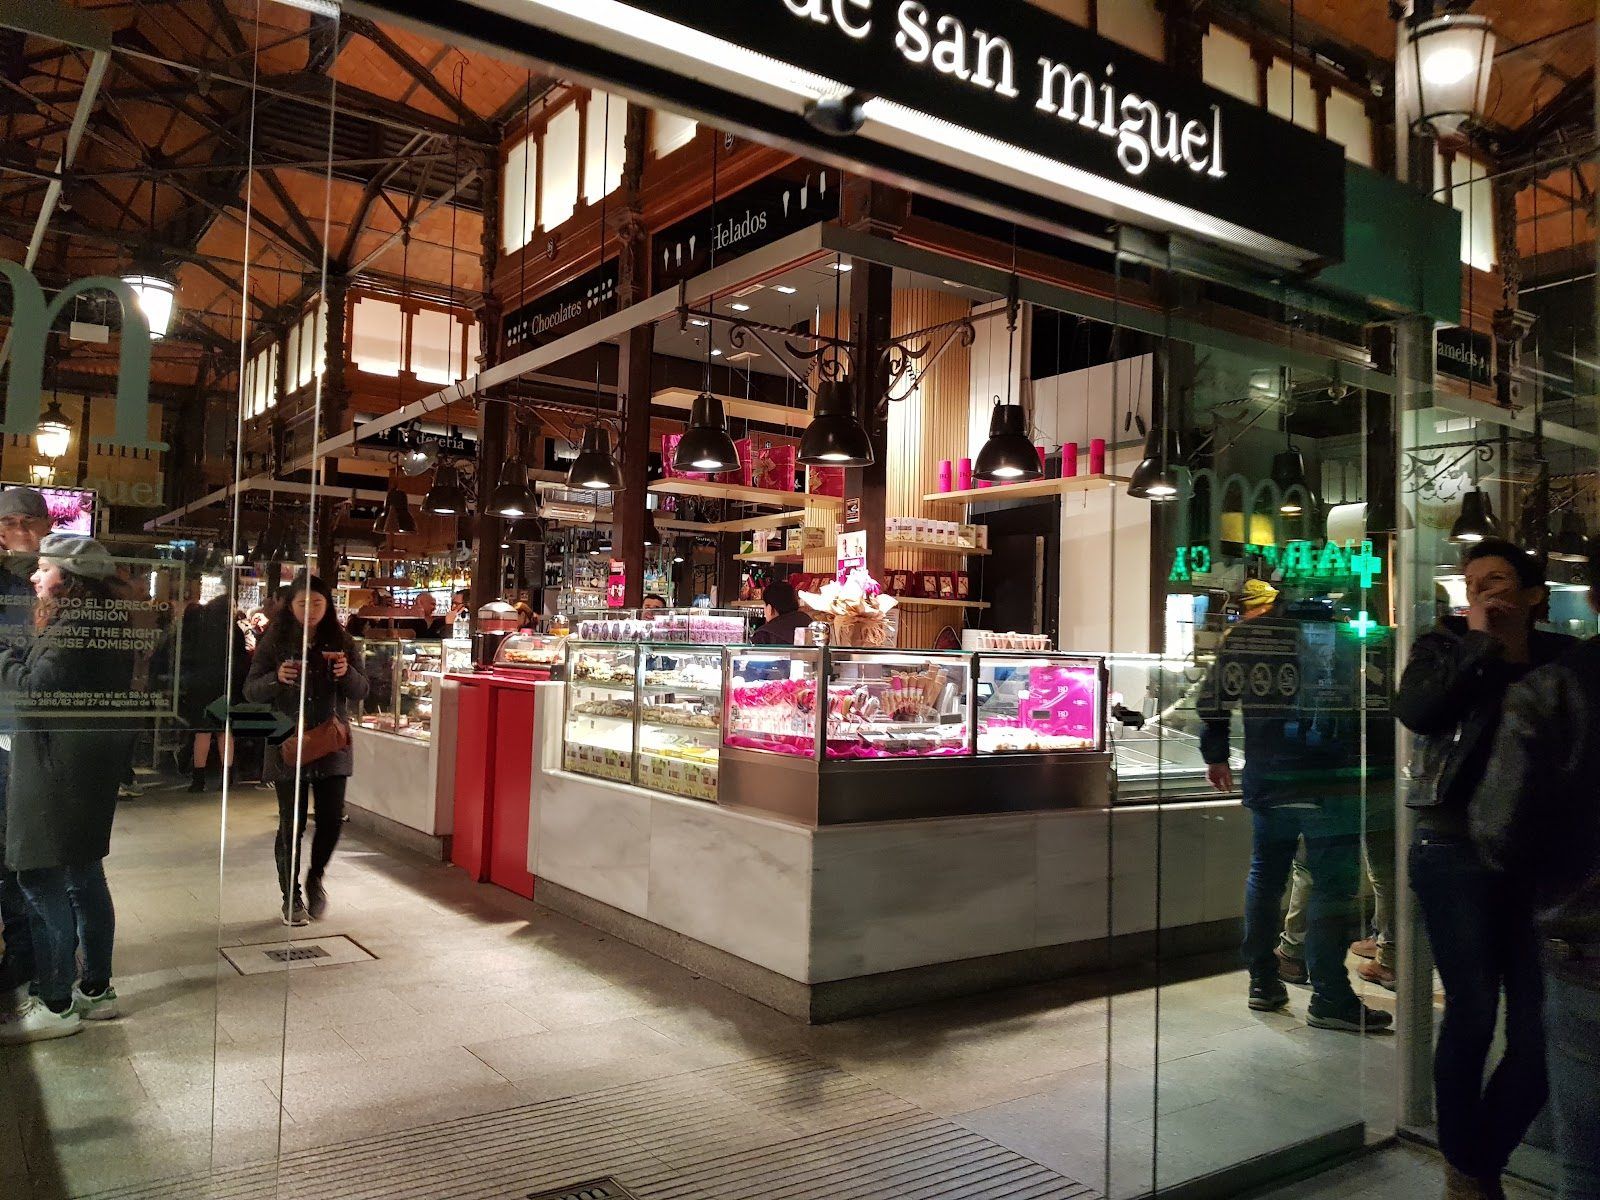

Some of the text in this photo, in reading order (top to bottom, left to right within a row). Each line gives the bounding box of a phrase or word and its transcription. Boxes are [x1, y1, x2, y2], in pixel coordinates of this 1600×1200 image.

[783, 0, 1228, 178] e san miguel
[712, 209, 767, 251] Helados
[531, 299, 582, 335] Chocolates
[85, 598, 101, 609] EL
[105, 599, 170, 611] DERECHO
[61, 608, 128, 621] ADMISIÓN
[93, 627, 120, 638] THE
[123, 628, 163, 640] RIGHT
[87, 639, 154, 650] ADMISION
